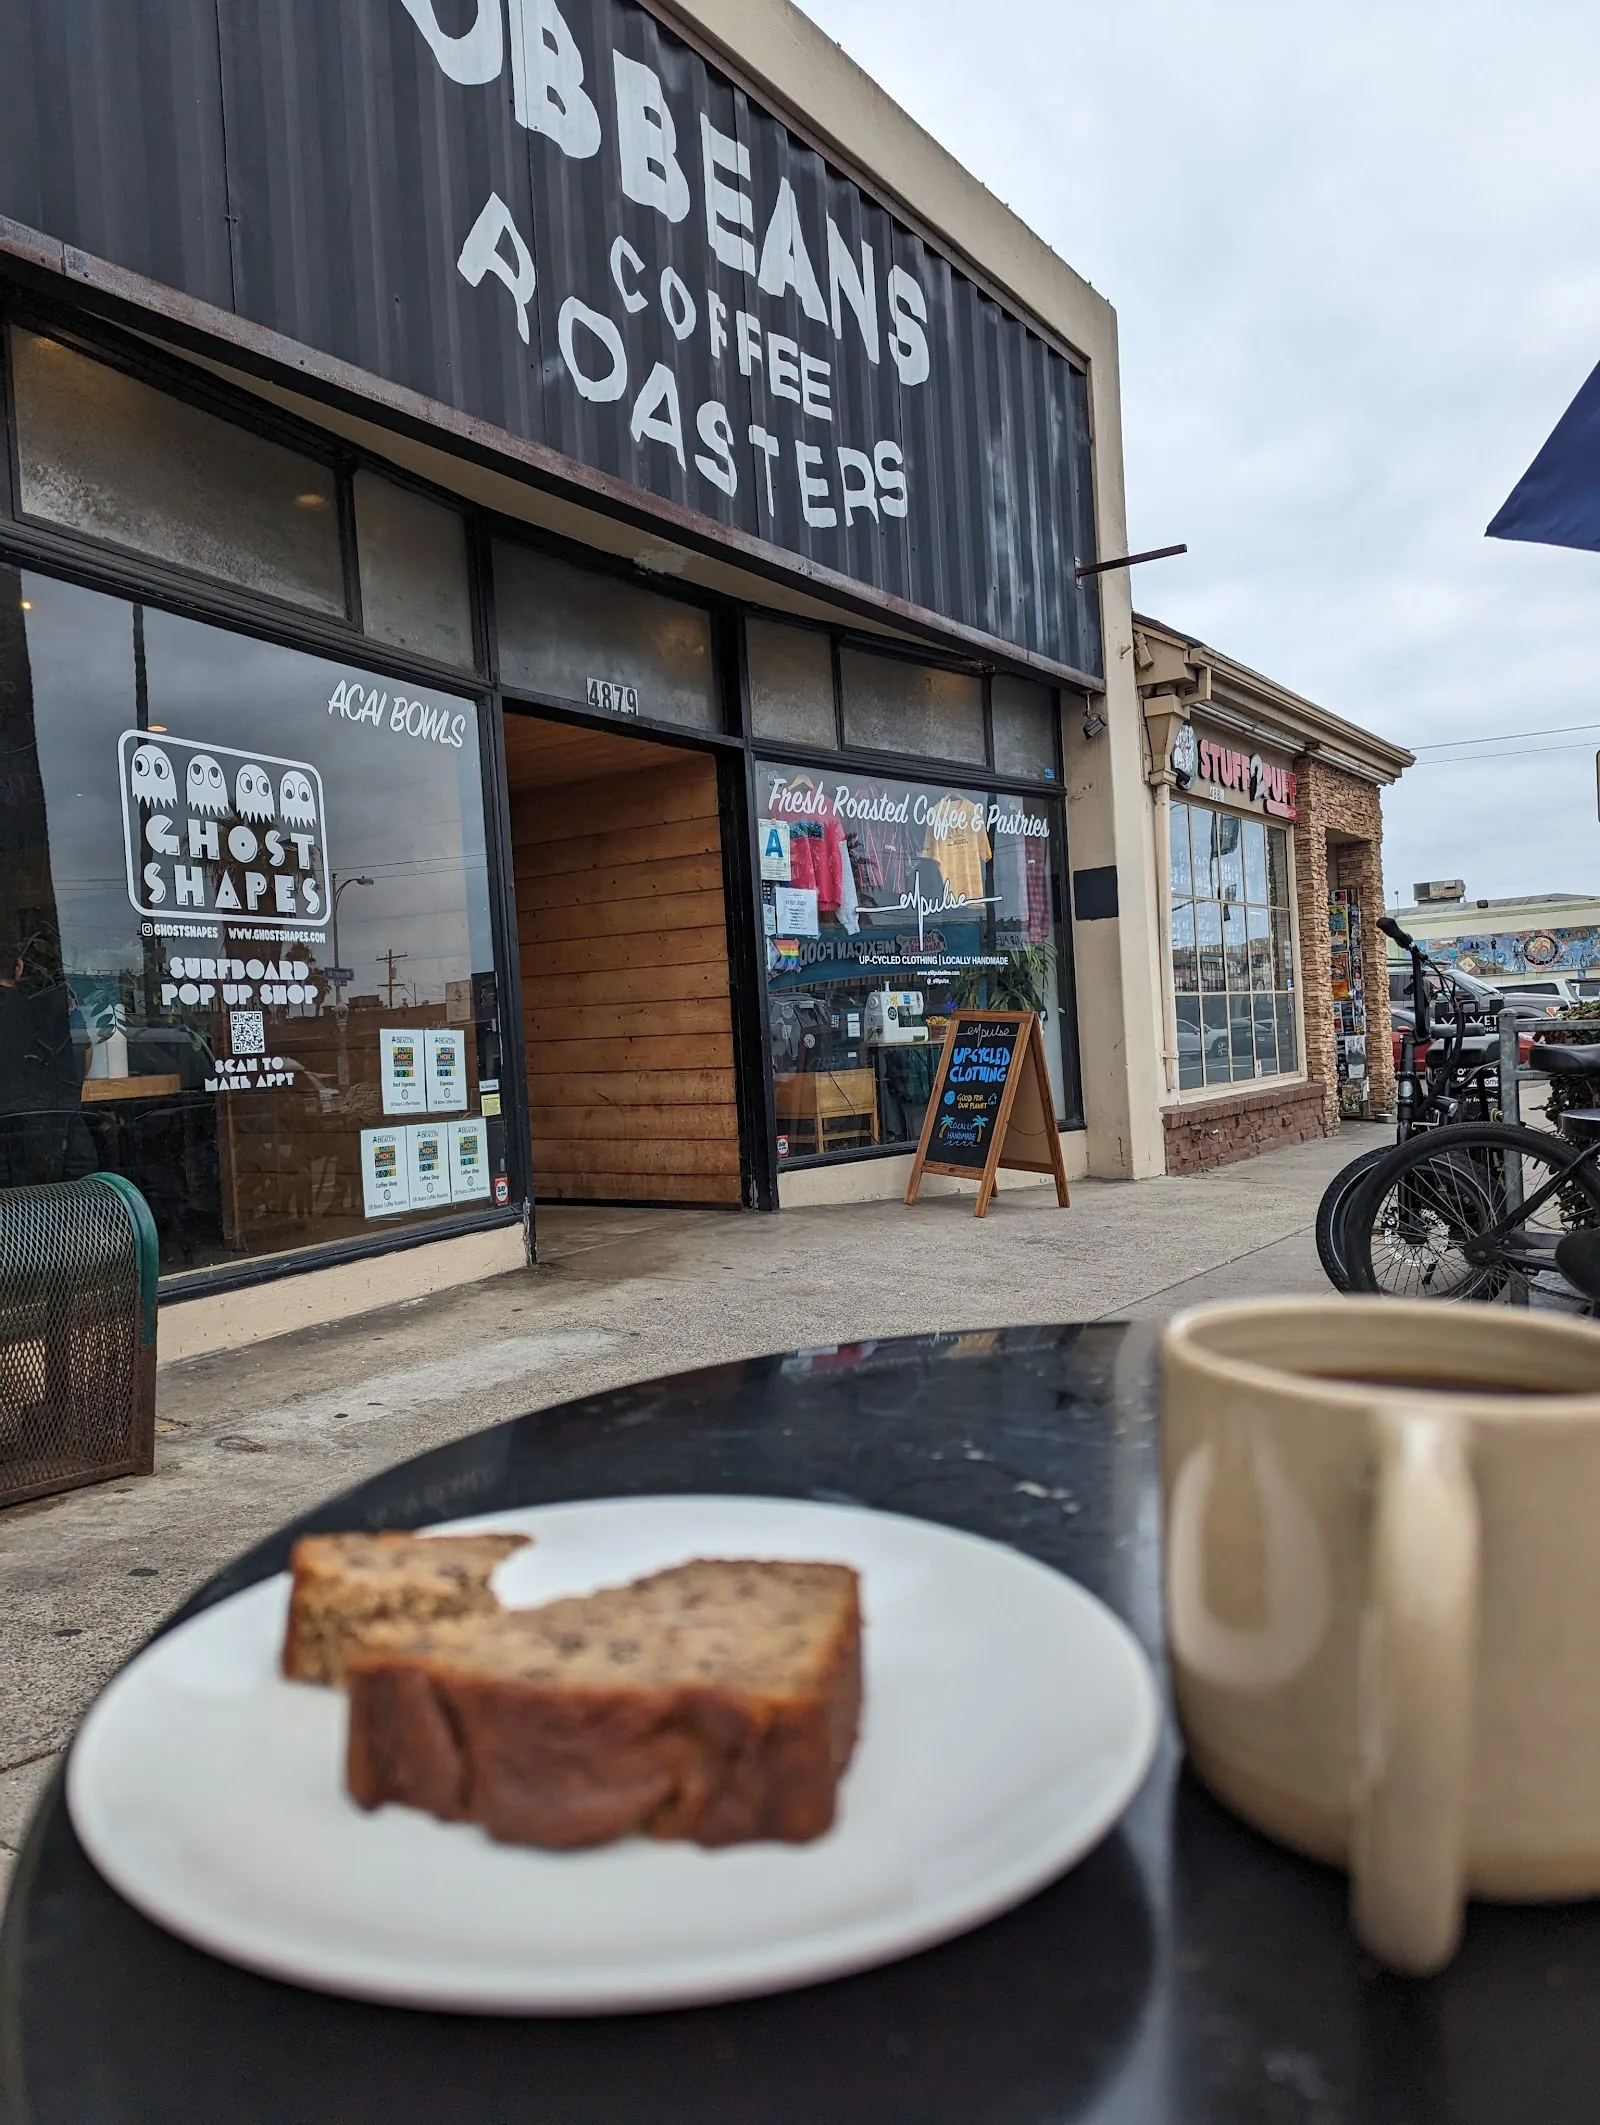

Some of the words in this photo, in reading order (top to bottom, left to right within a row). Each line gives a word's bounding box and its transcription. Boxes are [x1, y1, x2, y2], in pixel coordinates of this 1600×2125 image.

[613, 49, 929, 386] BEANS
[610, 235, 832, 421] COFFEE
[457, 192, 908, 529] ROASTERS
[589, 680, 637, 715] 4879
[328, 679, 387, 727] ACAI
[388, 696, 466, 748] BOWLS
[1200, 738, 1251, 790] STUFF
[1250, 753, 1266, 801] 2
[1262, 763, 1297, 806] PUFF
[768, 778, 828, 816] Fresh
[832, 785, 910, 824] Roasted
[913, 794, 968, 841] Coffee
[970, 803, 985, 832] &
[986, 806, 1050, 838] Pastries
[144, 814, 315, 870] GHOST
[765, 828, 784, 858] A
[143, 861, 320, 915] SHAPES
[154, 923, 219, 939] GHOSTSHAPES
[228, 927, 326, 943] WWW.GHOSTSHAPES.COM
[169, 956, 309, 981] SURFBOARD
[859, 955, 901, 965] UP-CYCLED
[901, 955, 938, 965] CLOTHING
[942, 956, 971, 965] LOCALLY
[971, 956, 1009, 966] HANDMADE
[161, 984, 216, 1006] POP
[222, 984, 253, 1005] UP
[260, 984, 318, 1005] SHOP
[214, 1058, 258, 1074] SCAN
[262, 1056, 284, 1071] TO
[953, 1047, 1011, 1066] UP-CYCLED
[204, 1075, 251, 1092] MAKE
[256, 1072, 295, 1088] APPT
[949, 1065, 1006, 1083] CLOTHING
[957, 1093, 973, 1102] GOOD
[973, 1094, 984, 1102] FOR
[375, 1168, 397, 1179] 202
[419, 1163, 439, 1172] 202
[431, 1174, 440, 1182] Shop
[388, 1180, 398, 1188] Shop
